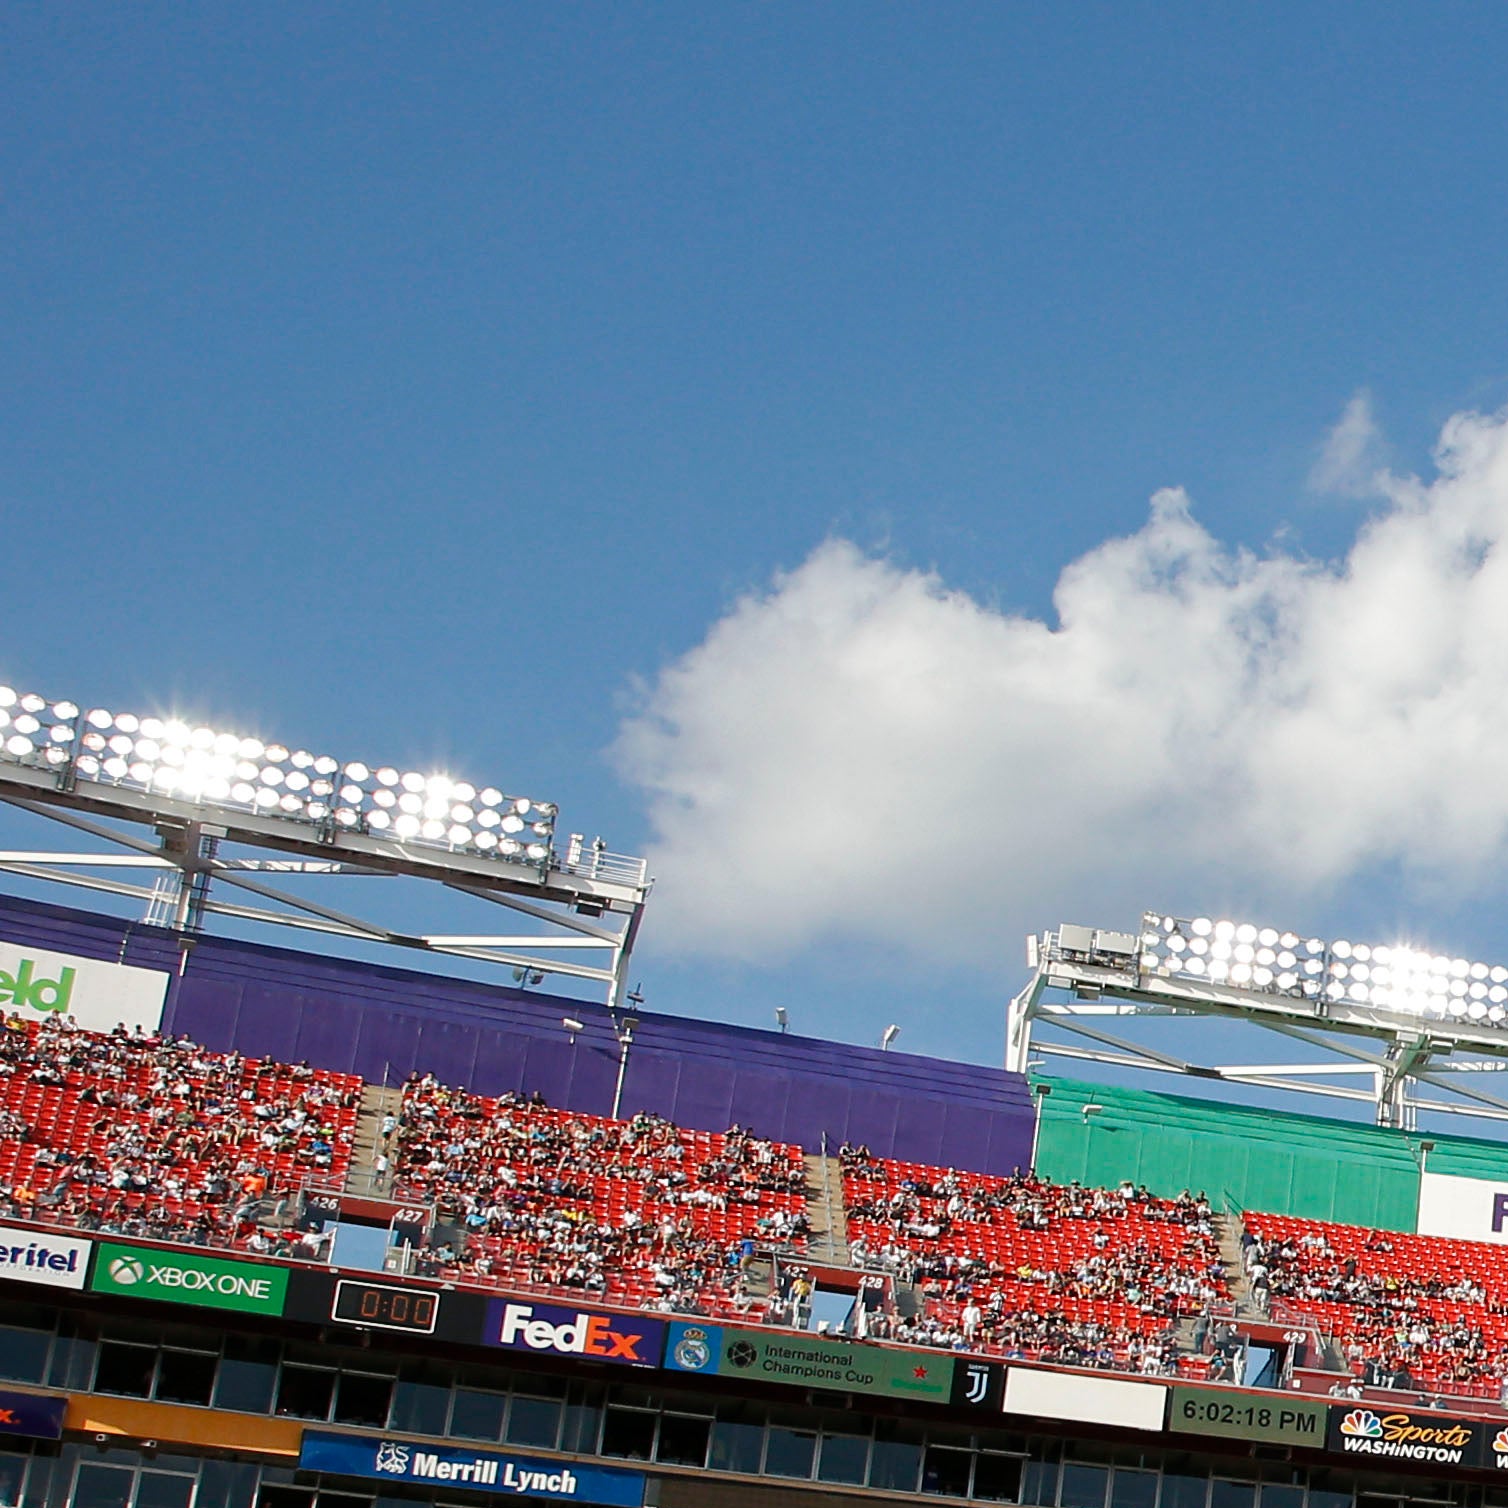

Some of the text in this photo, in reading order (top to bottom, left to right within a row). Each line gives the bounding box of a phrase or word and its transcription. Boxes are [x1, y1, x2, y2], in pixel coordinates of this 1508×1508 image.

[395, 1208, 425, 1223] 427
[148, 1265, 272, 1300] XBOX ONE
[860, 1276, 884, 1290] 428
[361, 1291, 432, 1325] 0:00
[501, 1304, 642, 1361] FedEx
[767, 1344, 855, 1367] International
[765, 1356, 875, 1387] Champions Cup
[1182, 1400, 1318, 1433] 6:02:18 PM
[1382, 1415, 1473, 1446] Sports
[1344, 1437, 1463, 1463] WASHINGTON
[413, 1452, 578, 1494] Merrill Lynch
